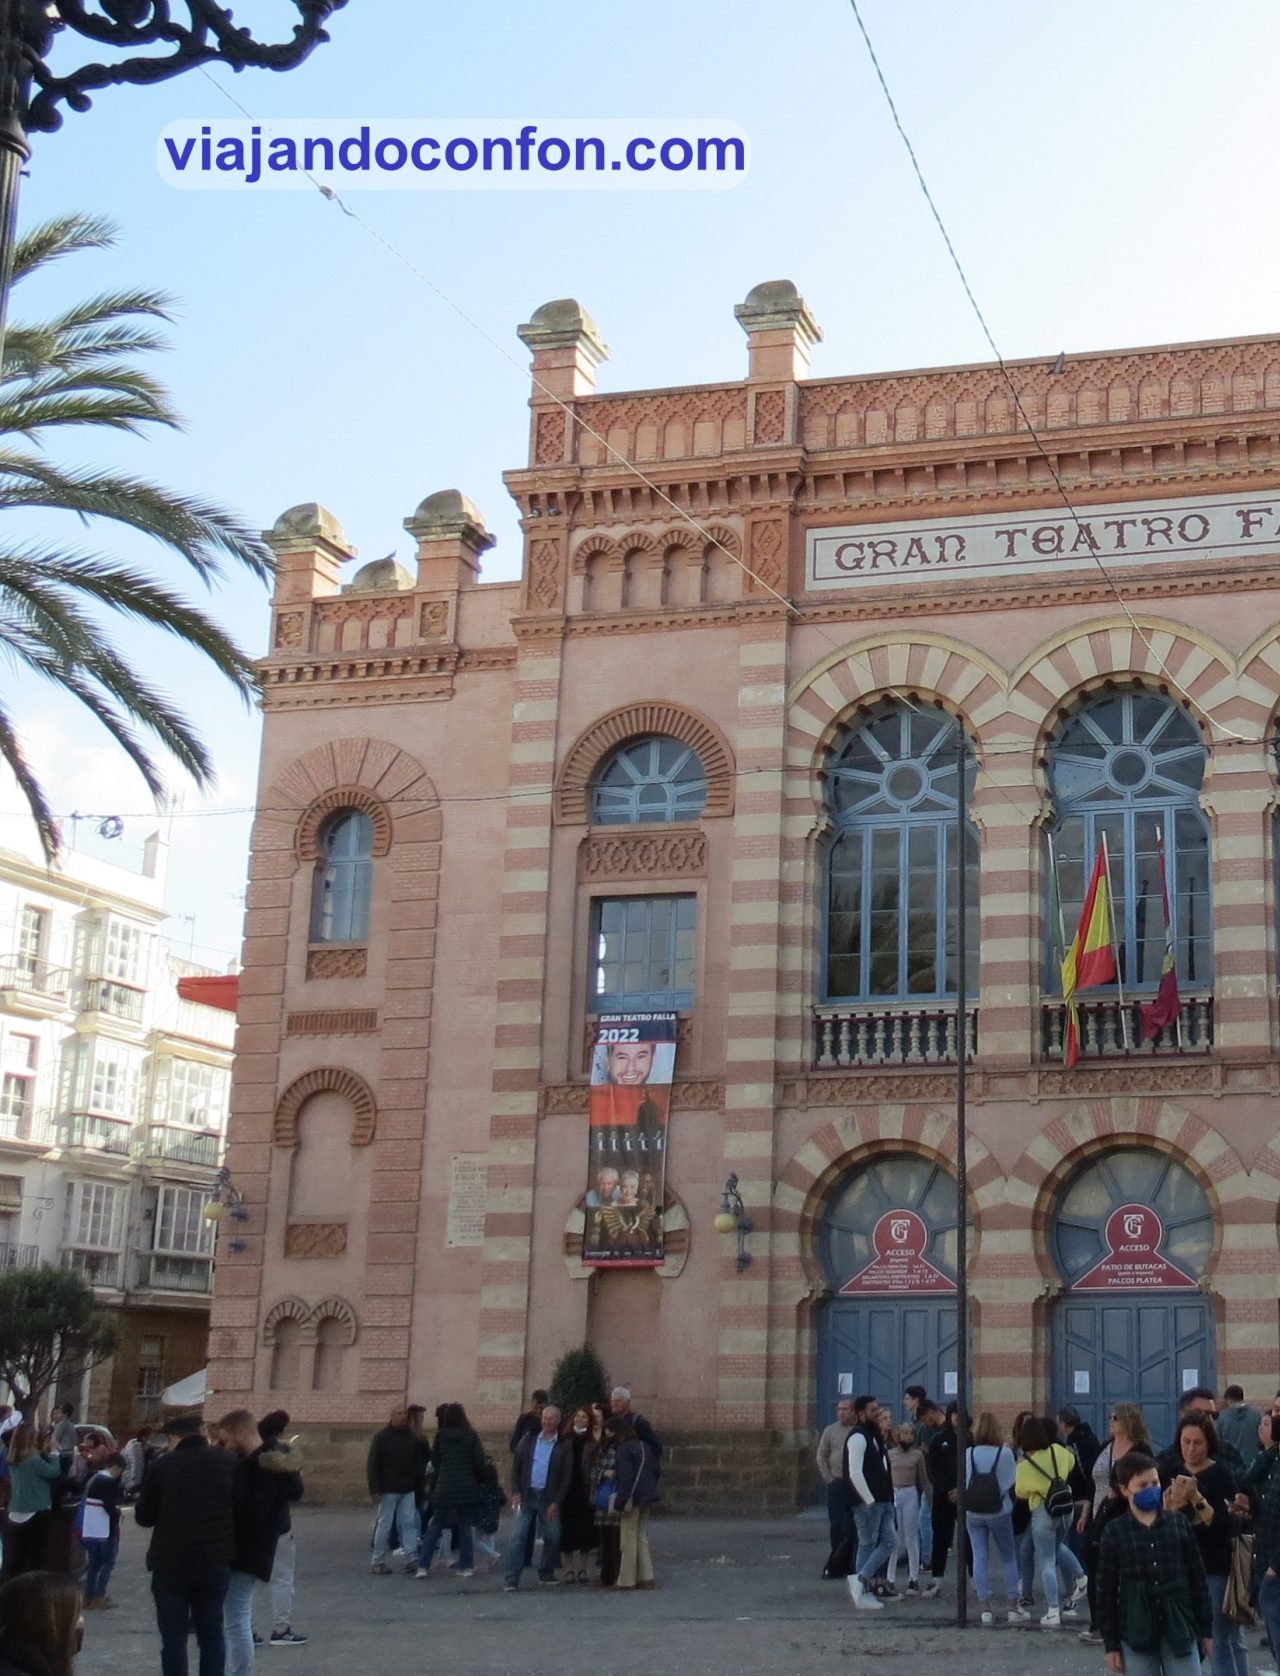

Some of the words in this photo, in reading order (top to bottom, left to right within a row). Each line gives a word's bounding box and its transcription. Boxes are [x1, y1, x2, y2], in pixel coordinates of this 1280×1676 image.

[834, 533, 966, 572] GRAN
[996, 513, 1211, 560] TEATRO
[598, 1029, 640, 1043] 2022
[1119, 1244, 1150, 1252] ACCESO
[1108, 1277, 1135, 1285] PALCOS
